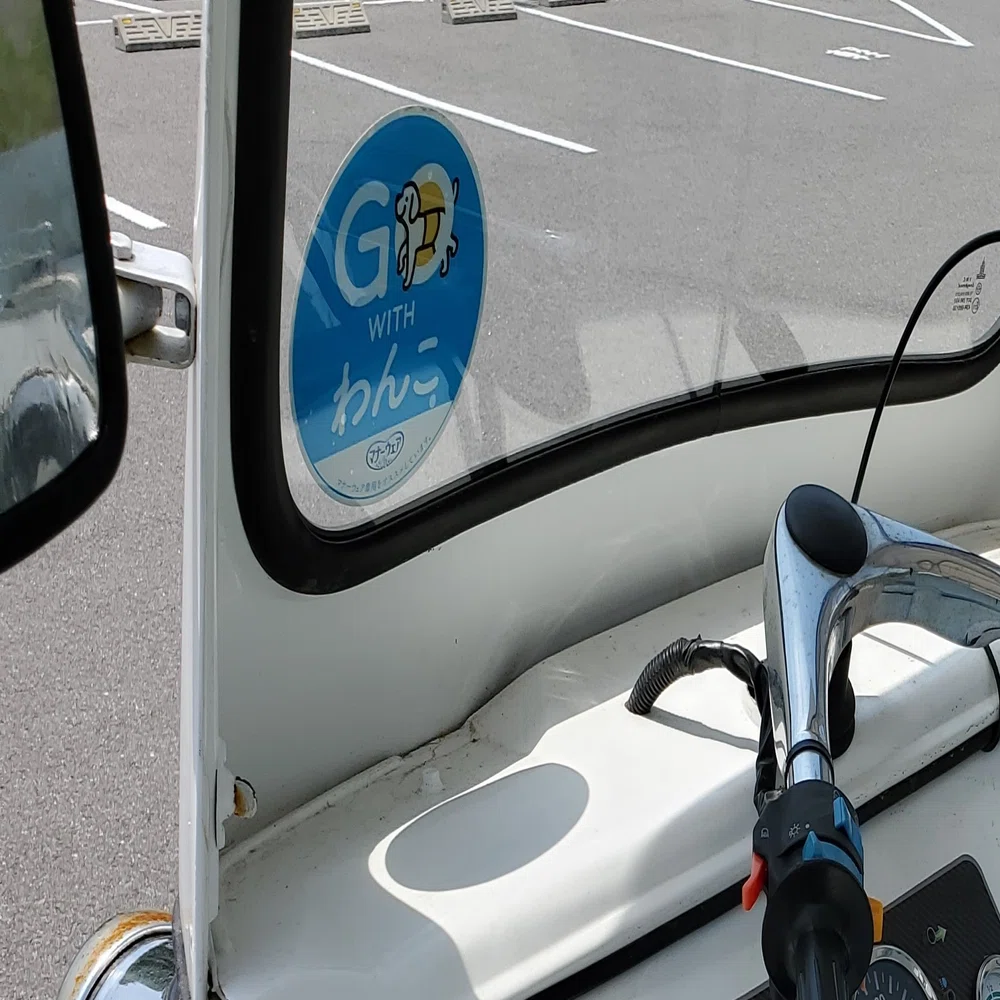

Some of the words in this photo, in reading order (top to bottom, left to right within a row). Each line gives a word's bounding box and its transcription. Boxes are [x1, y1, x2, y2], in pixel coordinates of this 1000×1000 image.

[367, 300, 416, 343] WITH
[331, 336, 439, 437] わんこ
